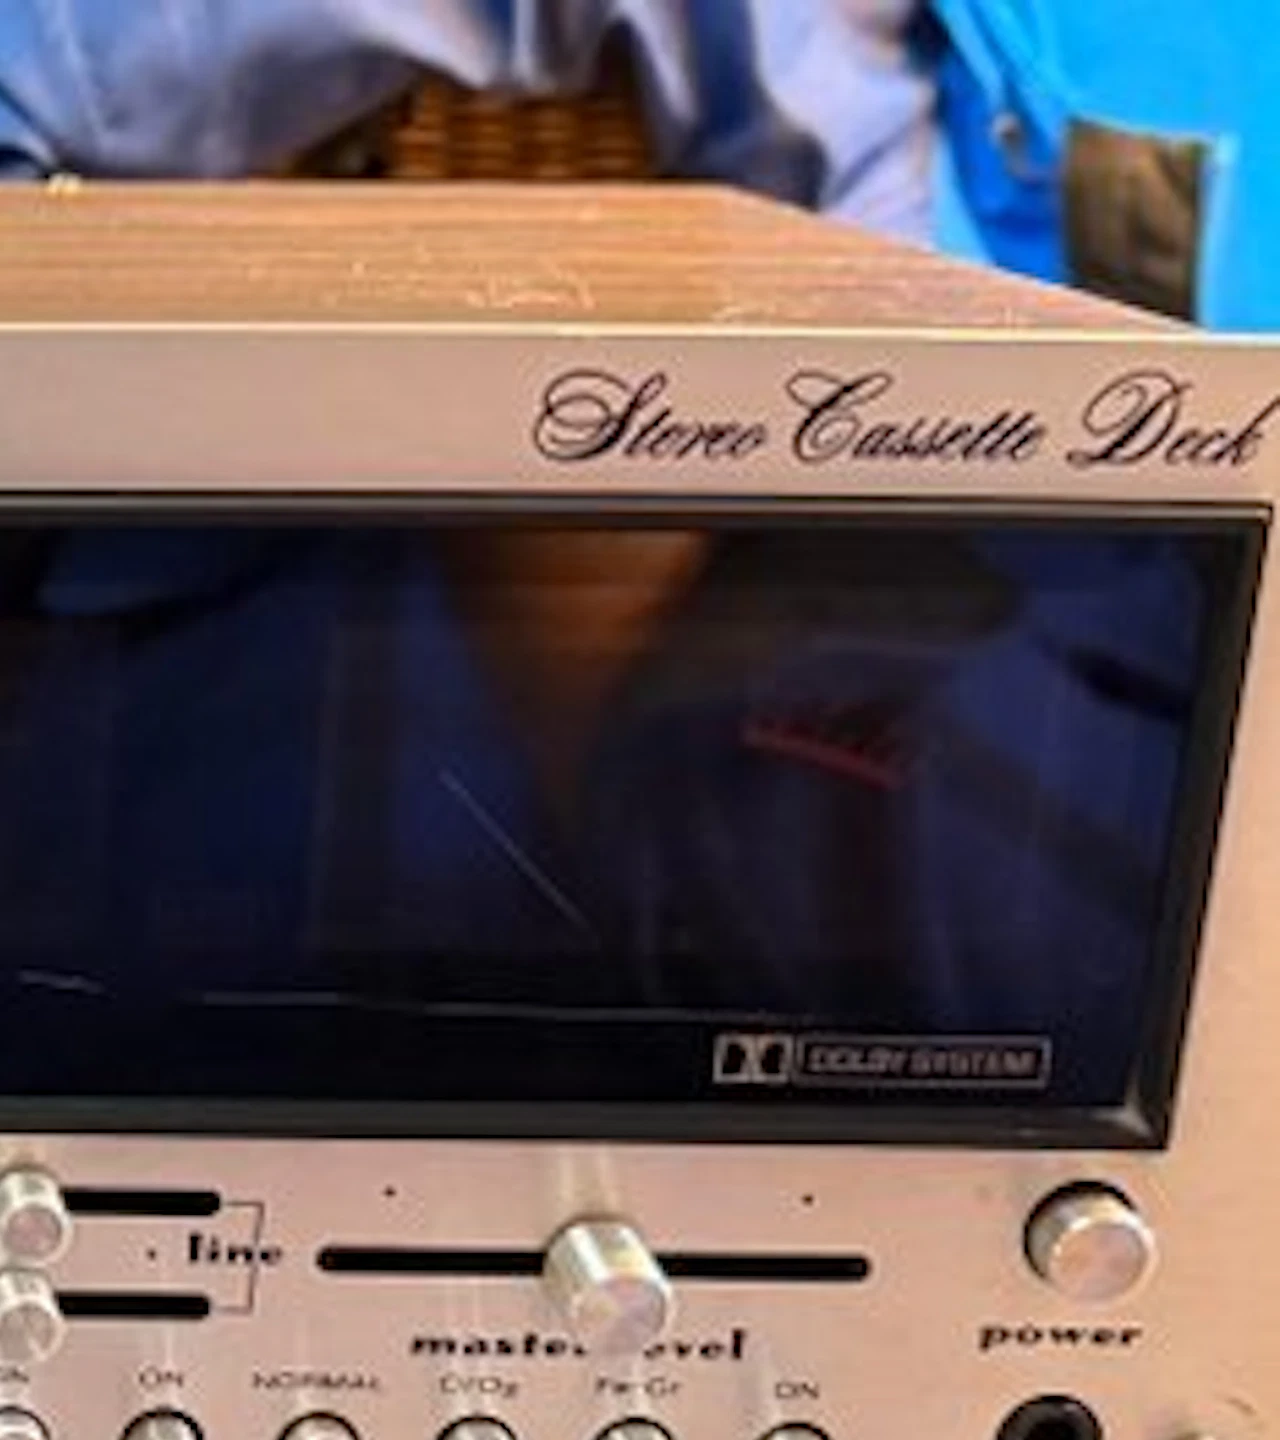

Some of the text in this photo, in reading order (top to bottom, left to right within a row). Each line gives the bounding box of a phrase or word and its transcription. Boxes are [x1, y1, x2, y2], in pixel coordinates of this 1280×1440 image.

[533, 368, 1279, 469] Stereo Cassette Deck
[187, 1231, 284, 1266] line
[410, 1328, 748, 1360] maste evel
[977, 1322, 1144, 1352] power
[140, 1368, 185, 1389] ON
[774, 1380, 820, 1399] ON
